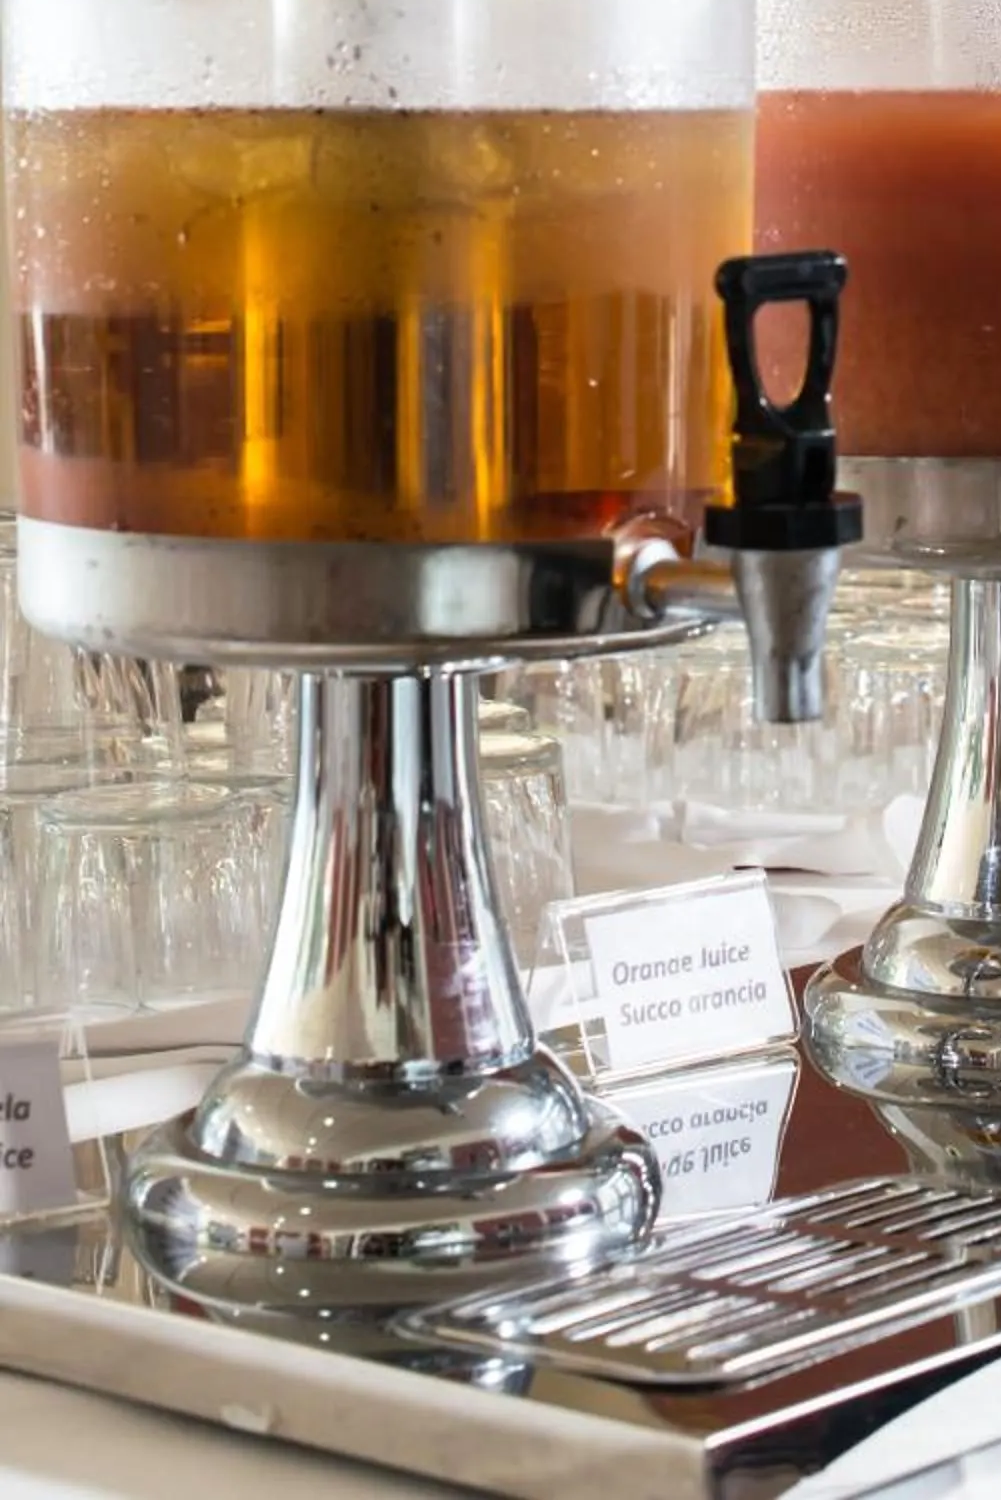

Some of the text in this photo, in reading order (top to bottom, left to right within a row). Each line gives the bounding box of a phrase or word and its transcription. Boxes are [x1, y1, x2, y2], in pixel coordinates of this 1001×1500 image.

[699, 940, 751, 969] Juice
[619, 978, 767, 1027] Succo arancia
[0, 1092, 31, 1121] la
